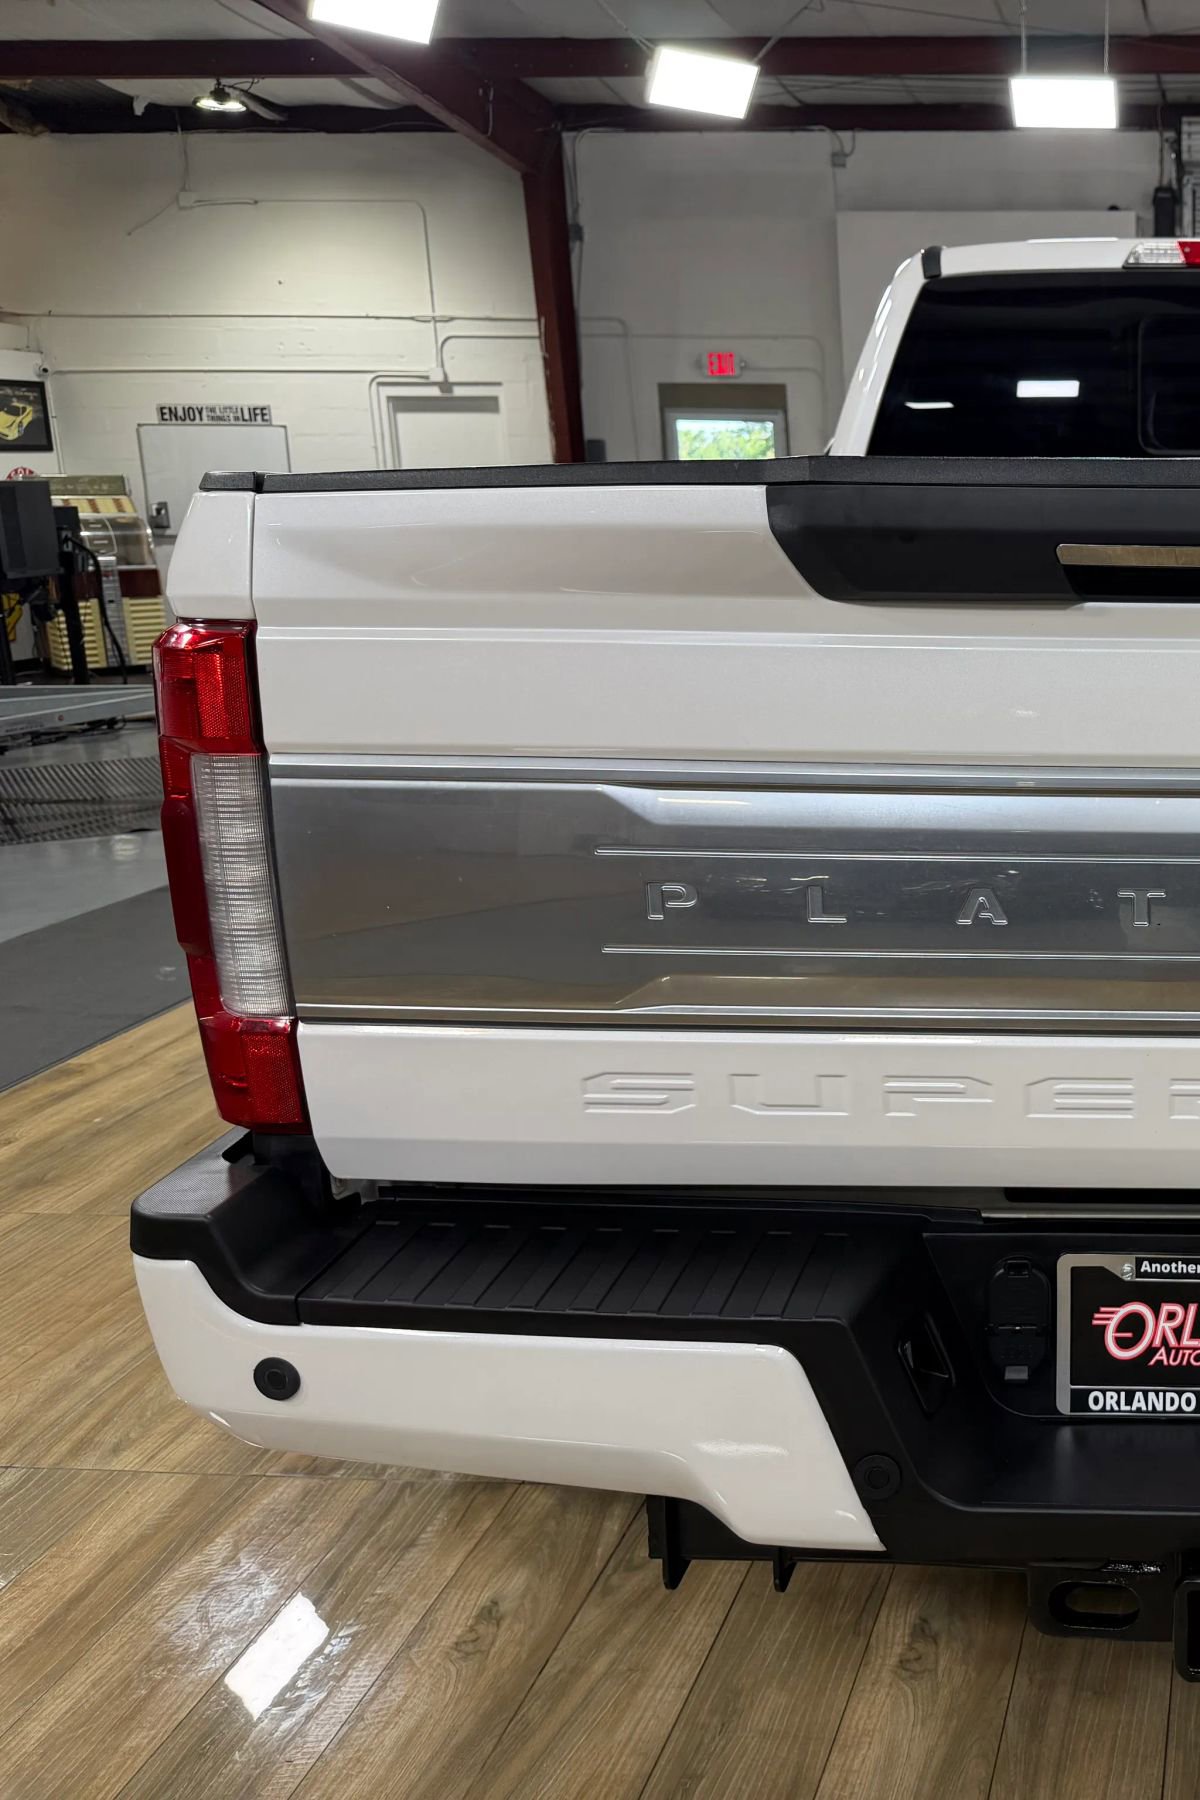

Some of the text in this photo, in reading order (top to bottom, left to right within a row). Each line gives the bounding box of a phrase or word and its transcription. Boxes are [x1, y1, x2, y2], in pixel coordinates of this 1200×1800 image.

[707, 352, 735, 376] EXIT
[160, 406, 203, 422] ENJOY
[240, 407, 269, 422] LIFE
[1088, 1390, 1197, 1413] ORLANDO
